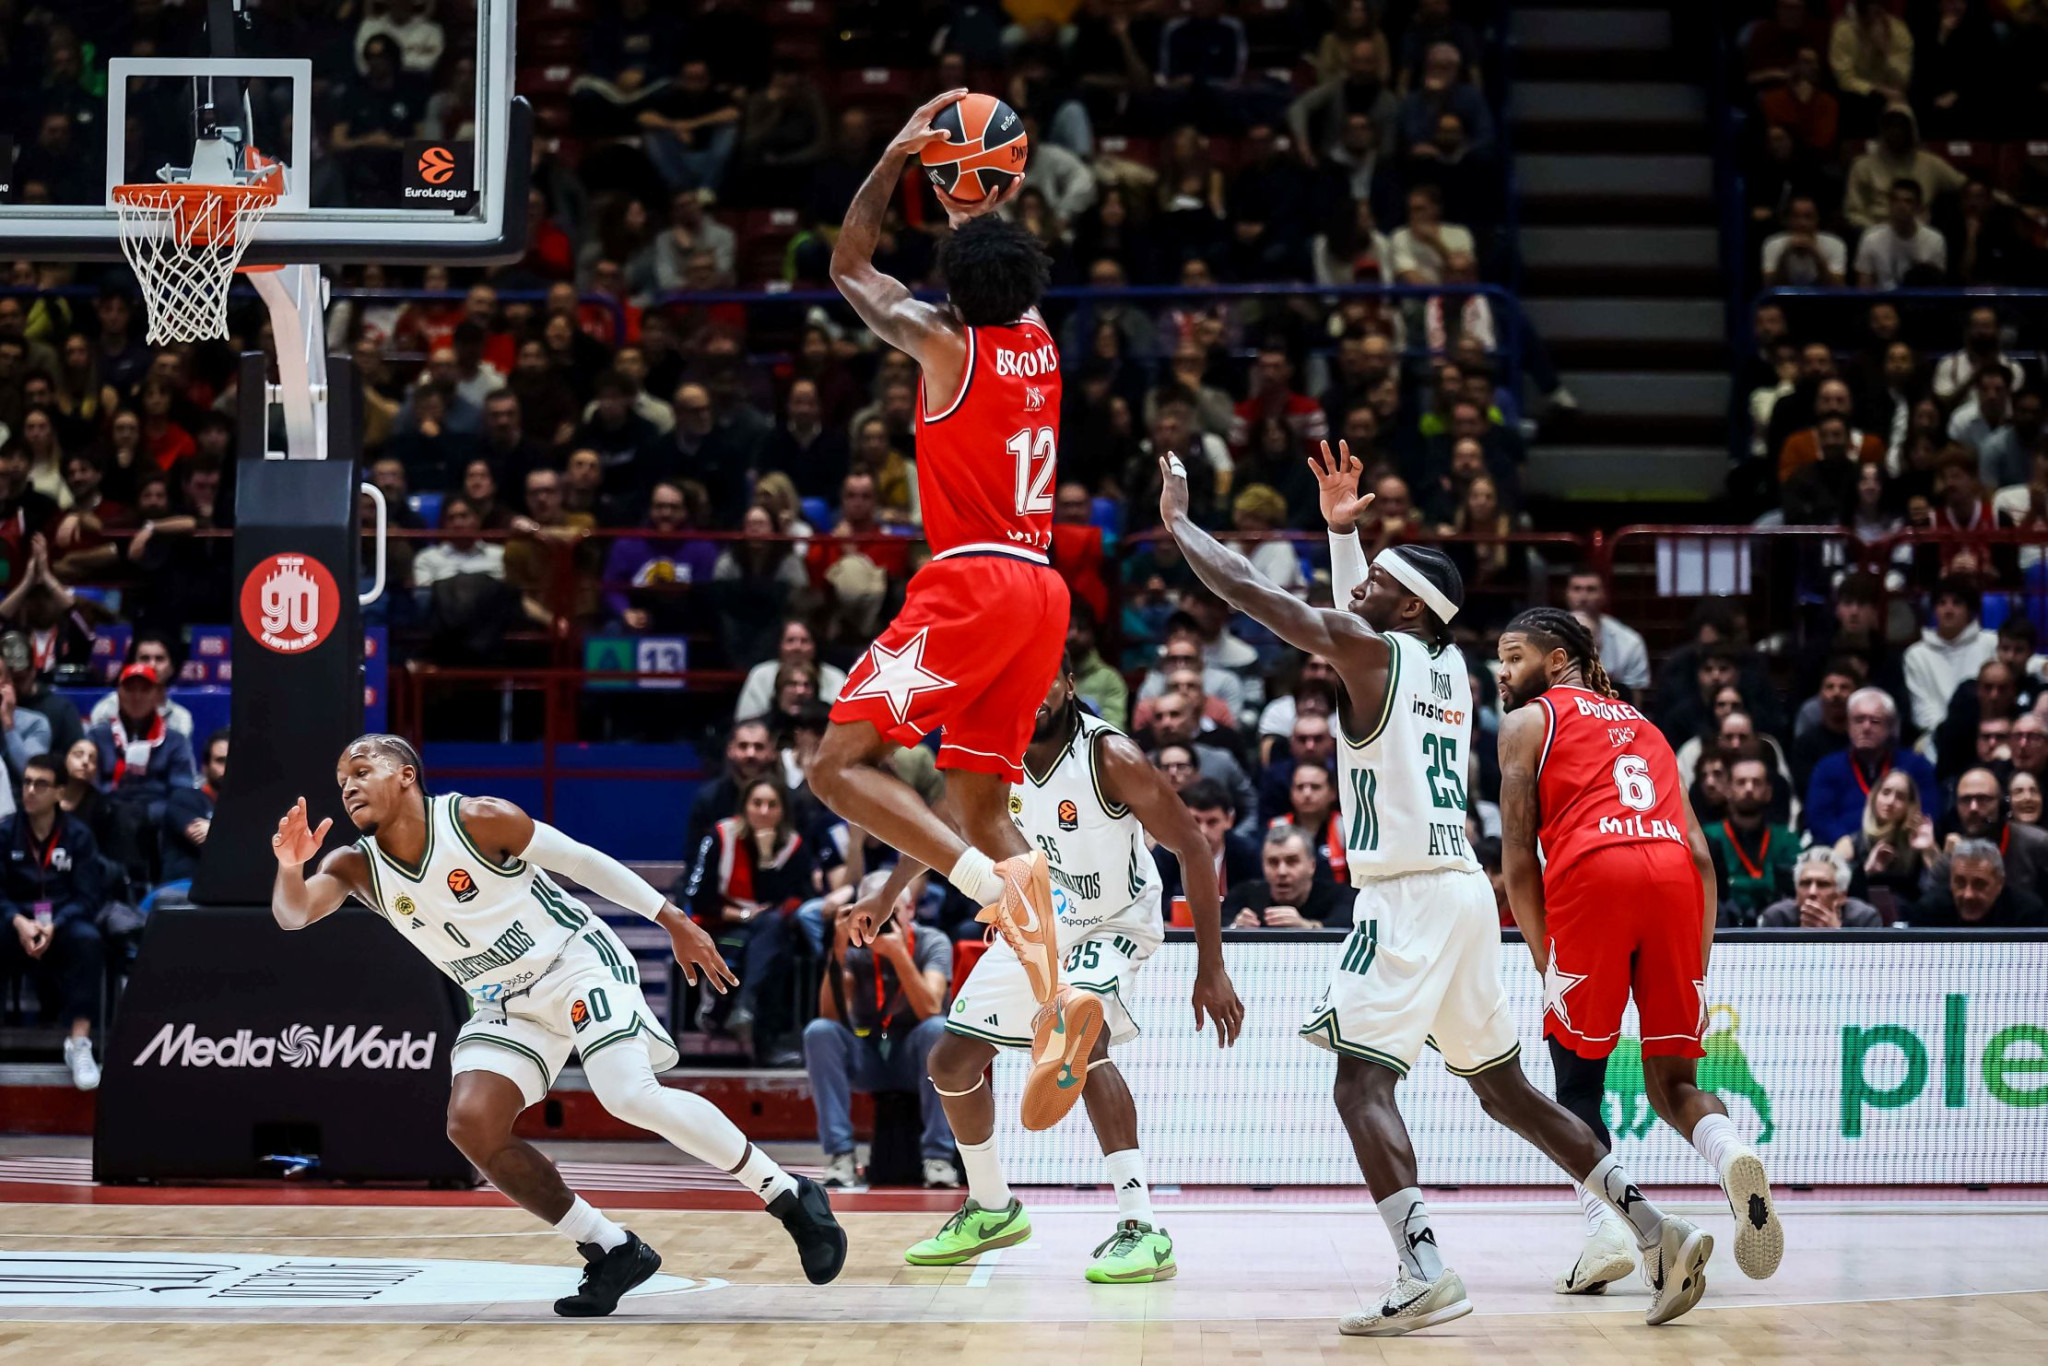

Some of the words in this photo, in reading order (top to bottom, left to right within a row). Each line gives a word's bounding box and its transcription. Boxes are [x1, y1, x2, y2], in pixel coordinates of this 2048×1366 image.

[404, 187, 467, 201] EuroLeague
[1006, 426, 1057, 516] 12
[261, 574, 320, 635] 90
[1422, 732, 1467, 812] 25
[1612, 754, 1656, 812] 6
[1036, 834, 1062, 865] 35
[443, 921, 471, 948] 0
[1067, 940, 1102, 973] 35
[588, 986, 612, 1023] 0
[133, 1023, 276, 1067] Media
[319, 1025, 437, 1070] World
[1842, 993, 2048, 1137] ple
